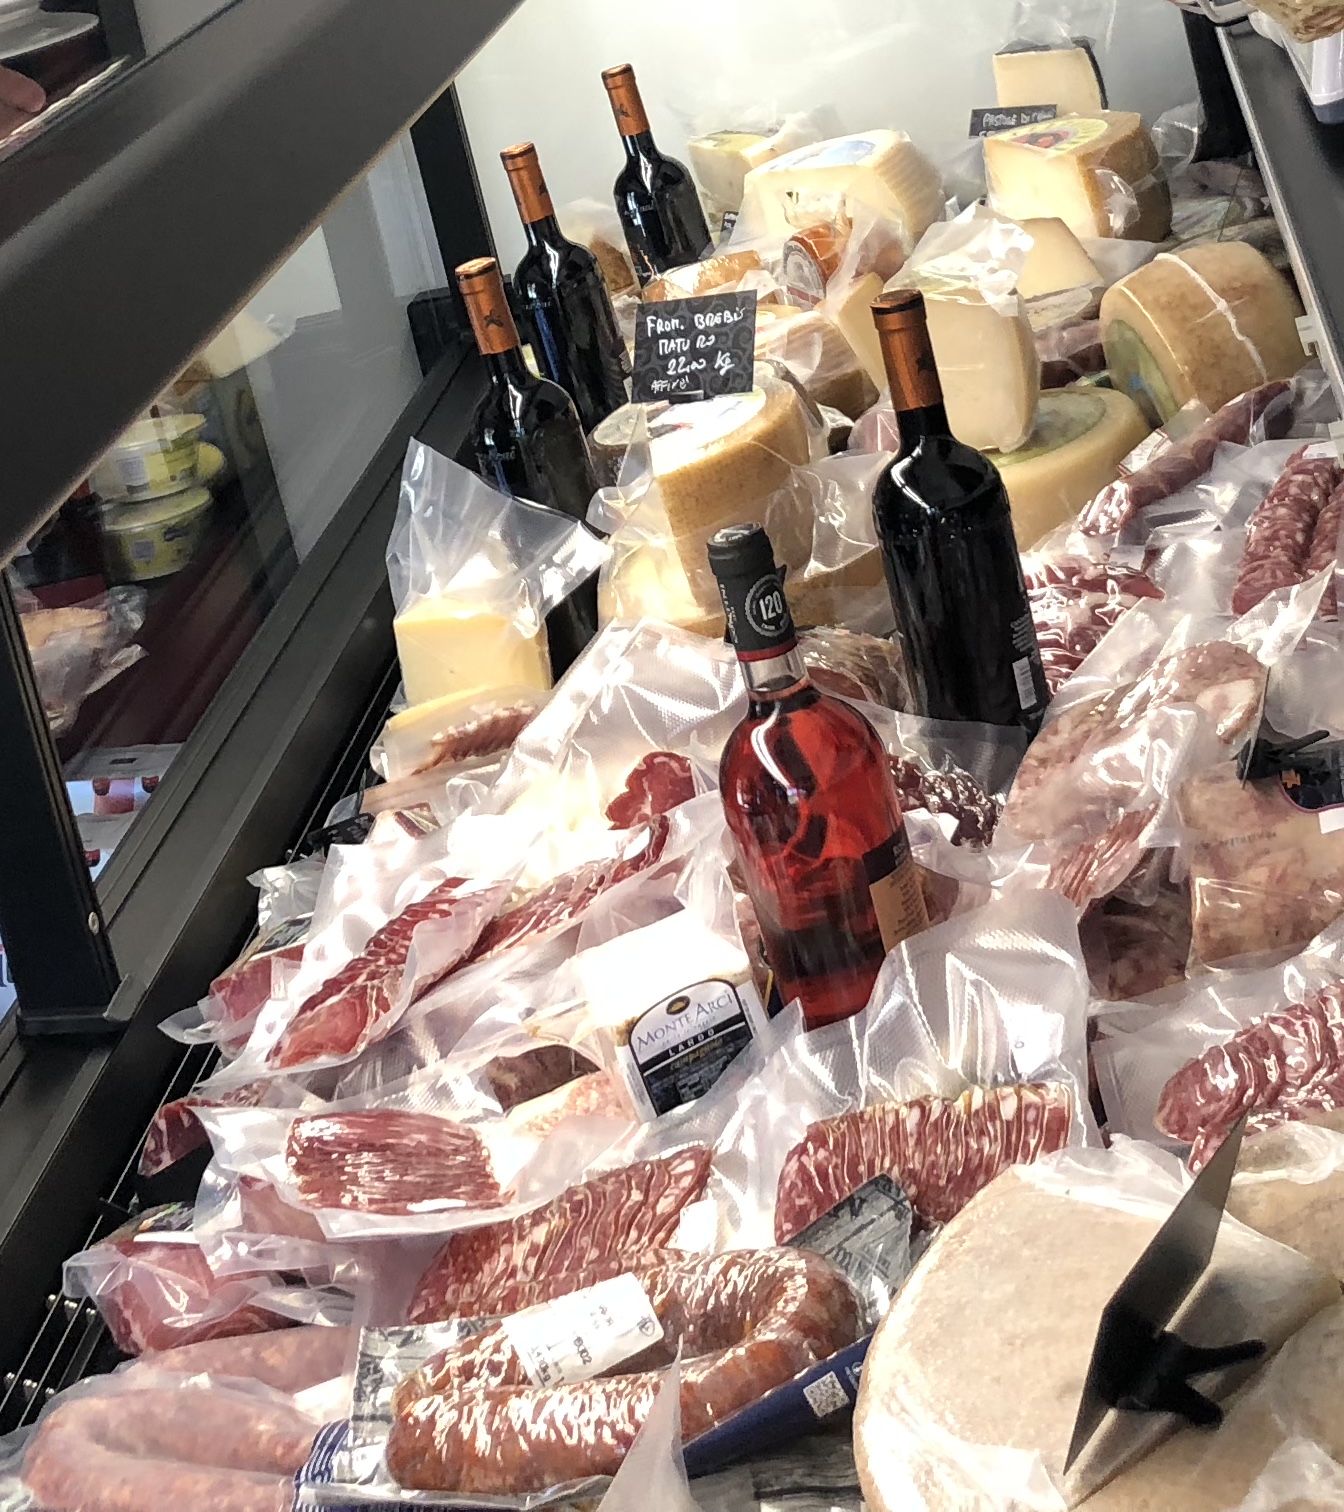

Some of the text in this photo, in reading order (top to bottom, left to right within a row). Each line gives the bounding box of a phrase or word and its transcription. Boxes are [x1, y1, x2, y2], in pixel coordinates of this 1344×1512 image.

[759, 590, 783, 621] 120
[636, 1012, 692, 1054] MONTE
[667, 1029, 715, 1057] LARDO
